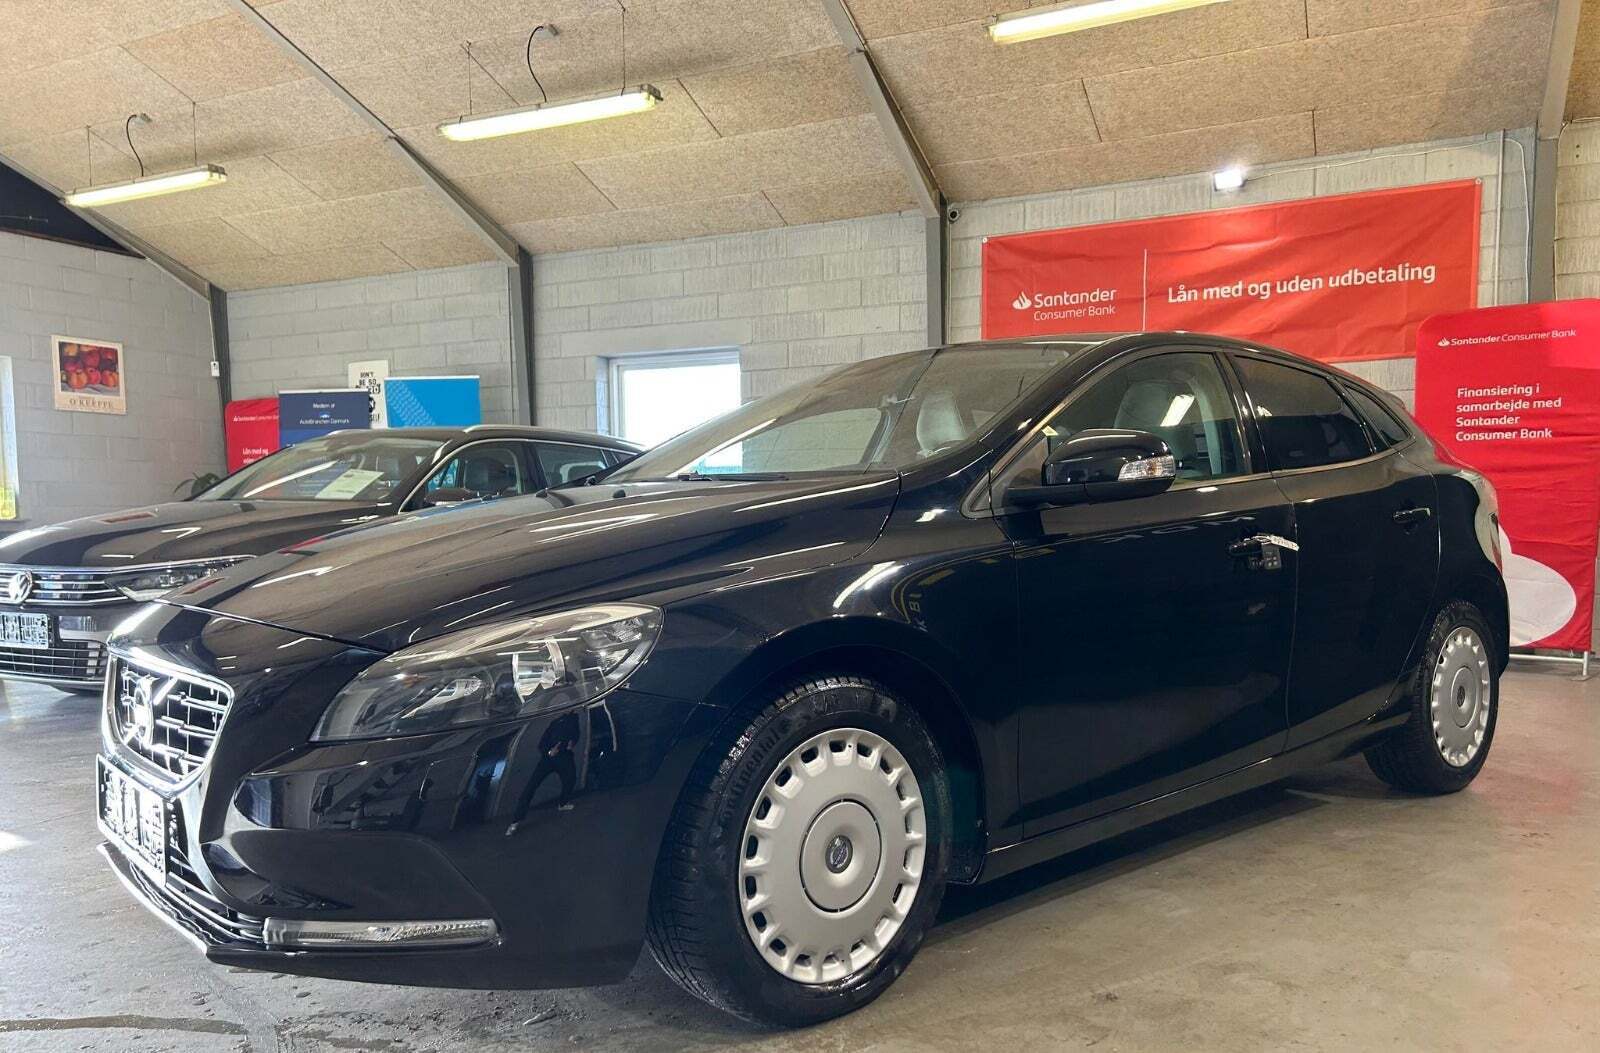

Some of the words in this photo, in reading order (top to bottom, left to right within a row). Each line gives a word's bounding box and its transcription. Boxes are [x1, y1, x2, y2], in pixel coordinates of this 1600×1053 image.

[1168, 284, 1198, 303] Lån
[1203, 280, 1243, 300] med
[1247, 281, 1271, 300] og
[1276, 275, 1323, 294] uden
[1328, 262, 1436, 288] udbetaling
[1034, 288, 1117, 309] Santander
[1033, 308, 1086, 321] Consumer
[1088, 304, 1116, 317] Bank
[1450, 334, 1500, 346] Santander
[1501, 330, 1550, 342] Consumer
[1551, 327, 1577, 339] Bank
[1457, 384, 1533, 398] Finansiering
[1535, 382, 1540, 394] i
[1456, 399, 1530, 413] samarbejde
[1533, 397, 1562, 408] med
[1456, 415, 1520, 427] Santander
[1455, 431, 1518, 442] Consumer
[1520, 428, 1553, 439] Bank
